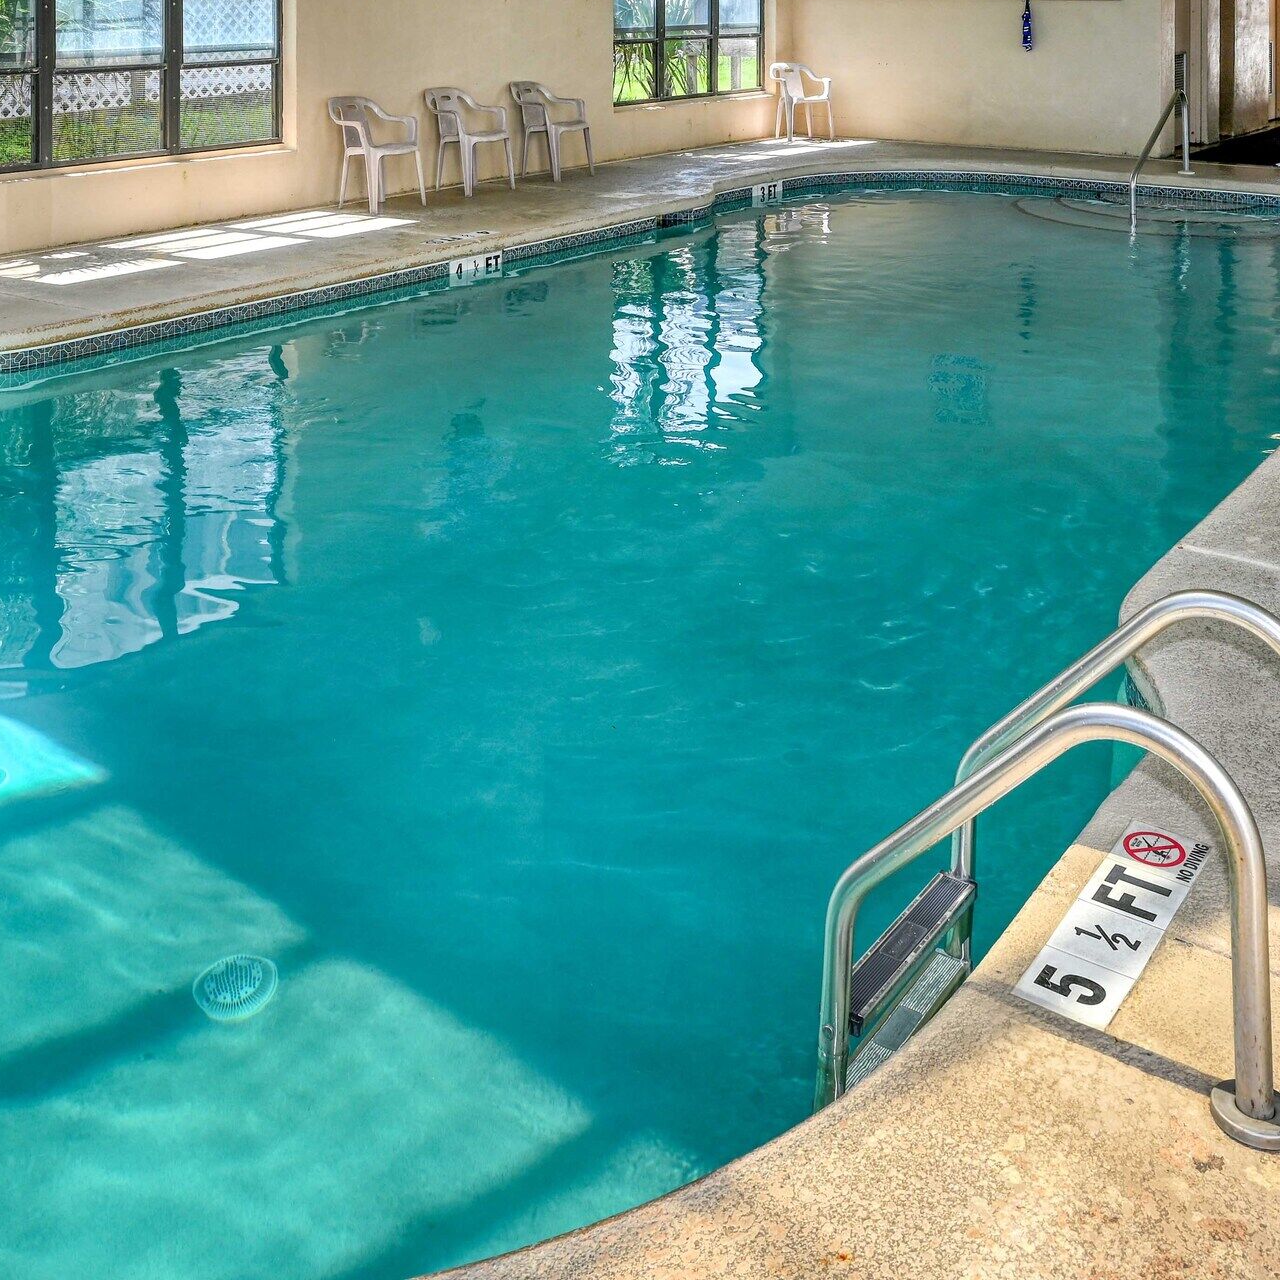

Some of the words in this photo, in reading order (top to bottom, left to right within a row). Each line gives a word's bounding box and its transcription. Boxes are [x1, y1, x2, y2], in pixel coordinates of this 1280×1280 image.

[1176, 869, 1192, 883] NO
[1189, 843, 1209, 872] DIVING
[1034, 964, 1106, 1006] 5
[1091, 864, 1172, 922] FT
